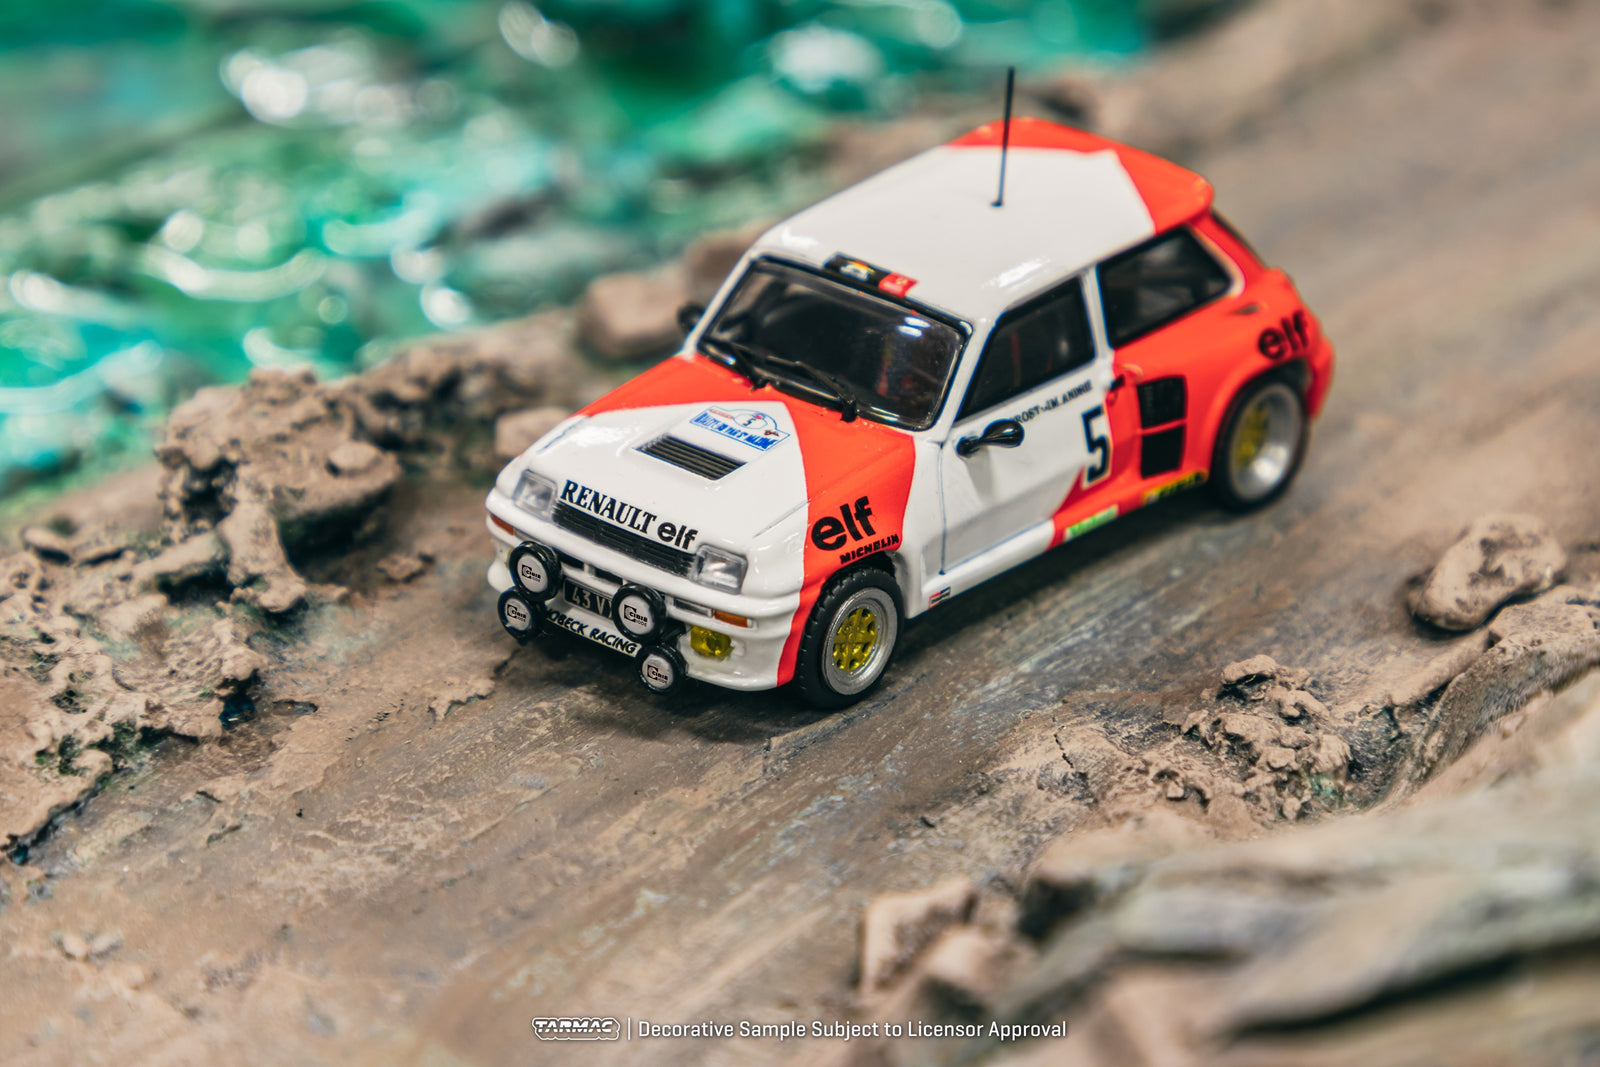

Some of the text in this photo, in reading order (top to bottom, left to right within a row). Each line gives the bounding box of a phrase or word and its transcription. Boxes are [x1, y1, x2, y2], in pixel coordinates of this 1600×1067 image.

[1257, 309, 1309, 360] elf
[1081, 403, 1110, 483] 5
[560, 479, 699, 551] RENAULT elf
[811, 496, 876, 551] elf
[839, 533, 900, 564] MICHELIN
[572, 586, 591, 609] 43
[546, 608, 637, 654] OBECK RACING
